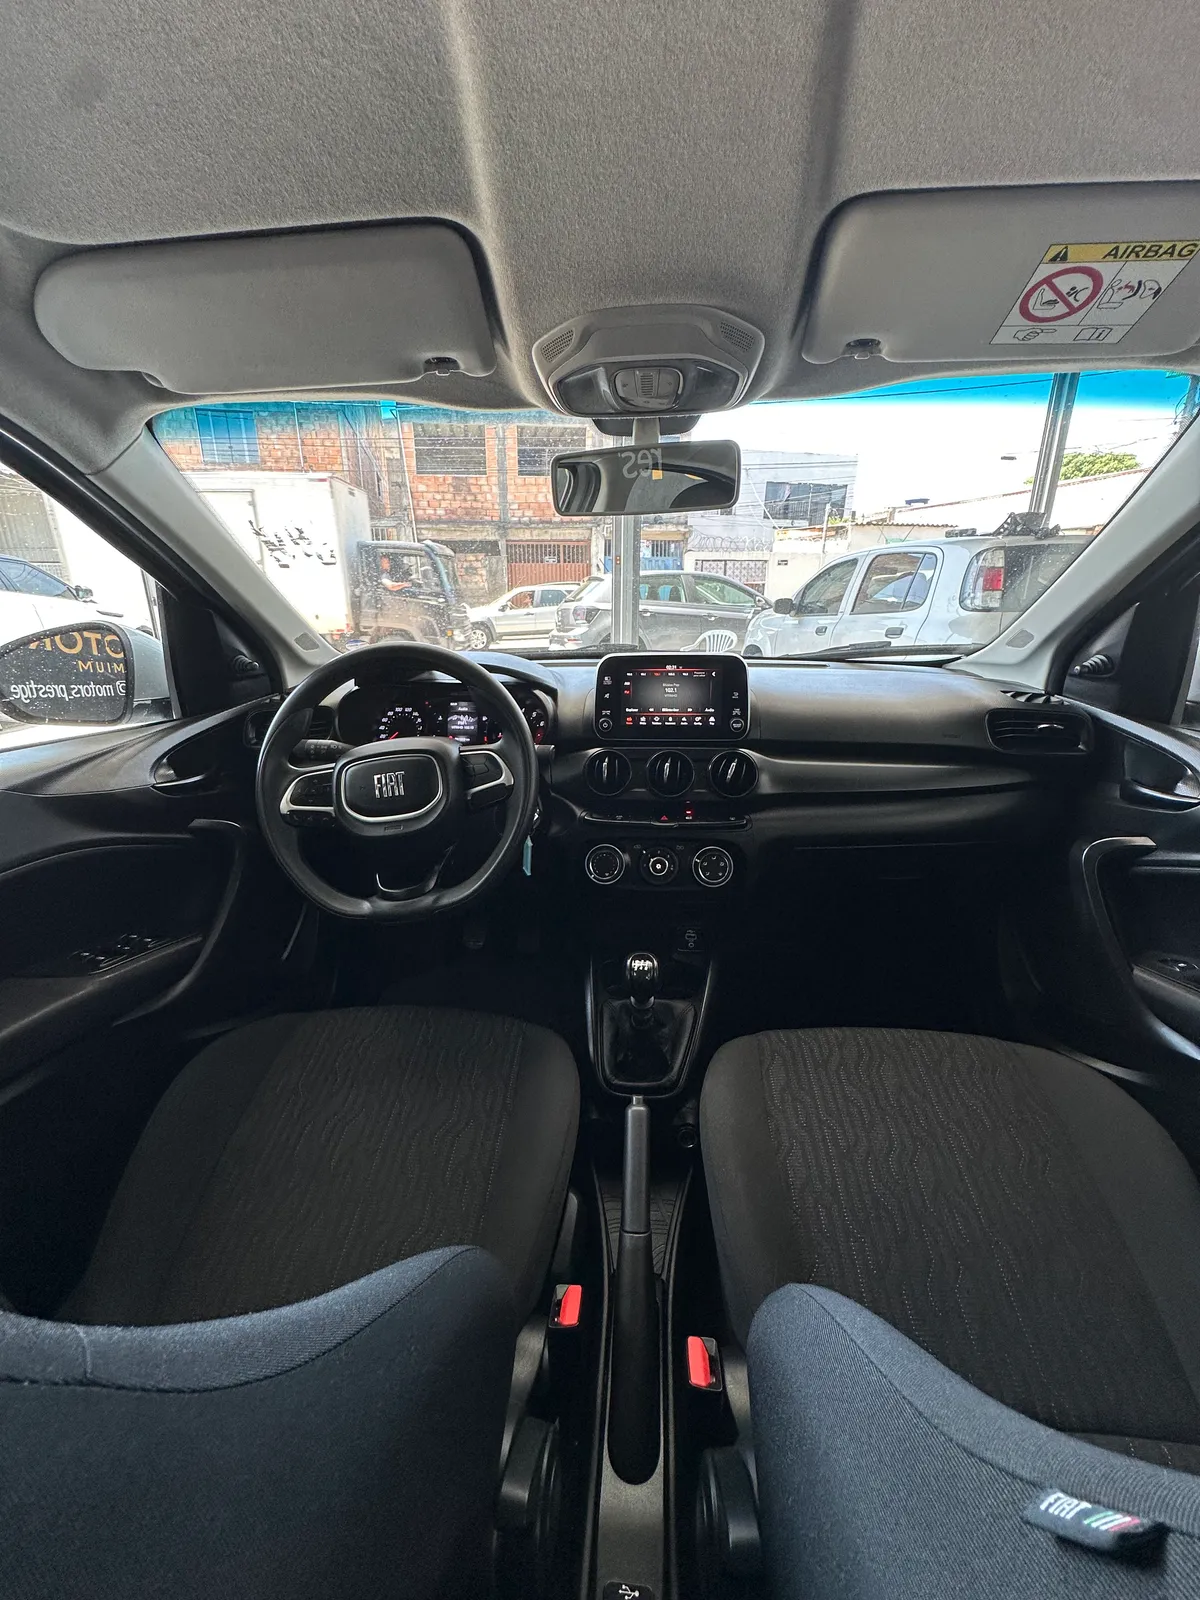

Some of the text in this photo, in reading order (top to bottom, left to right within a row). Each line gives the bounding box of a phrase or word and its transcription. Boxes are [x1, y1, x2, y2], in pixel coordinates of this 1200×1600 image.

[1102, 242, 1199, 260] AIRBAG
[373, 771, 405, 799] FIAT
[1039, 1492, 1092, 1520] FIAT
